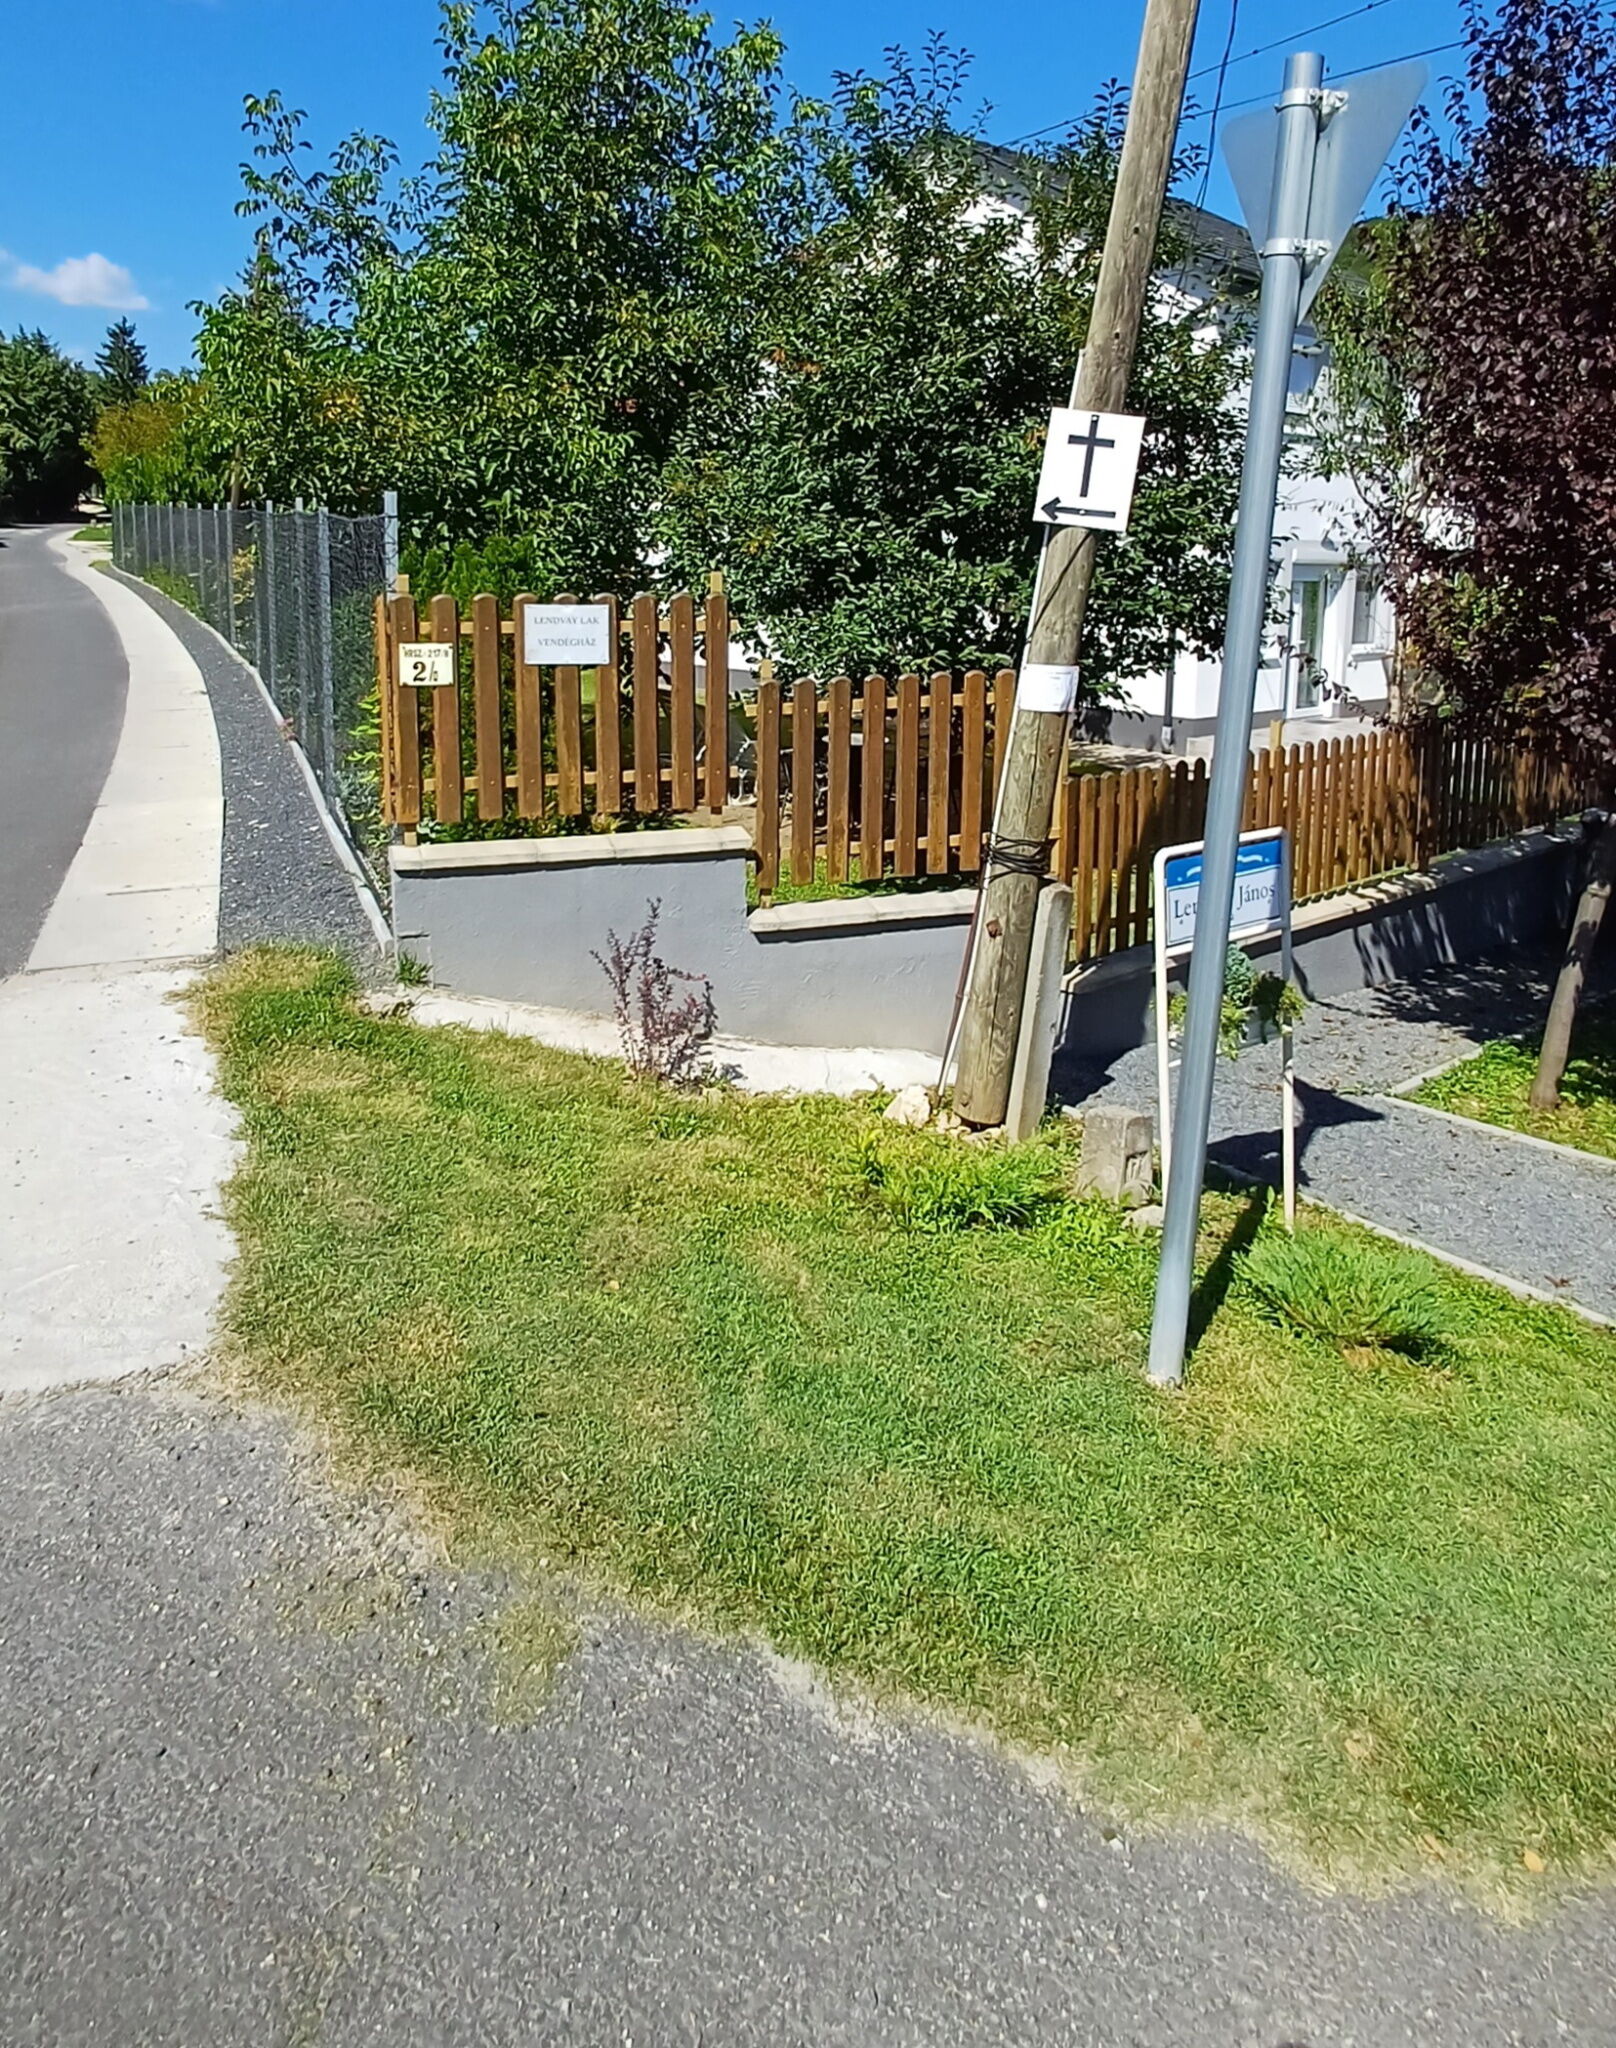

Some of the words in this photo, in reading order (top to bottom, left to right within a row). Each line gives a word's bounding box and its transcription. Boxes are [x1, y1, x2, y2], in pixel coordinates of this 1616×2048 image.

[533, 616, 578, 625] LENDVAY
[580, 616, 600, 625] LAK
[1236, 883, 1276, 911] János
